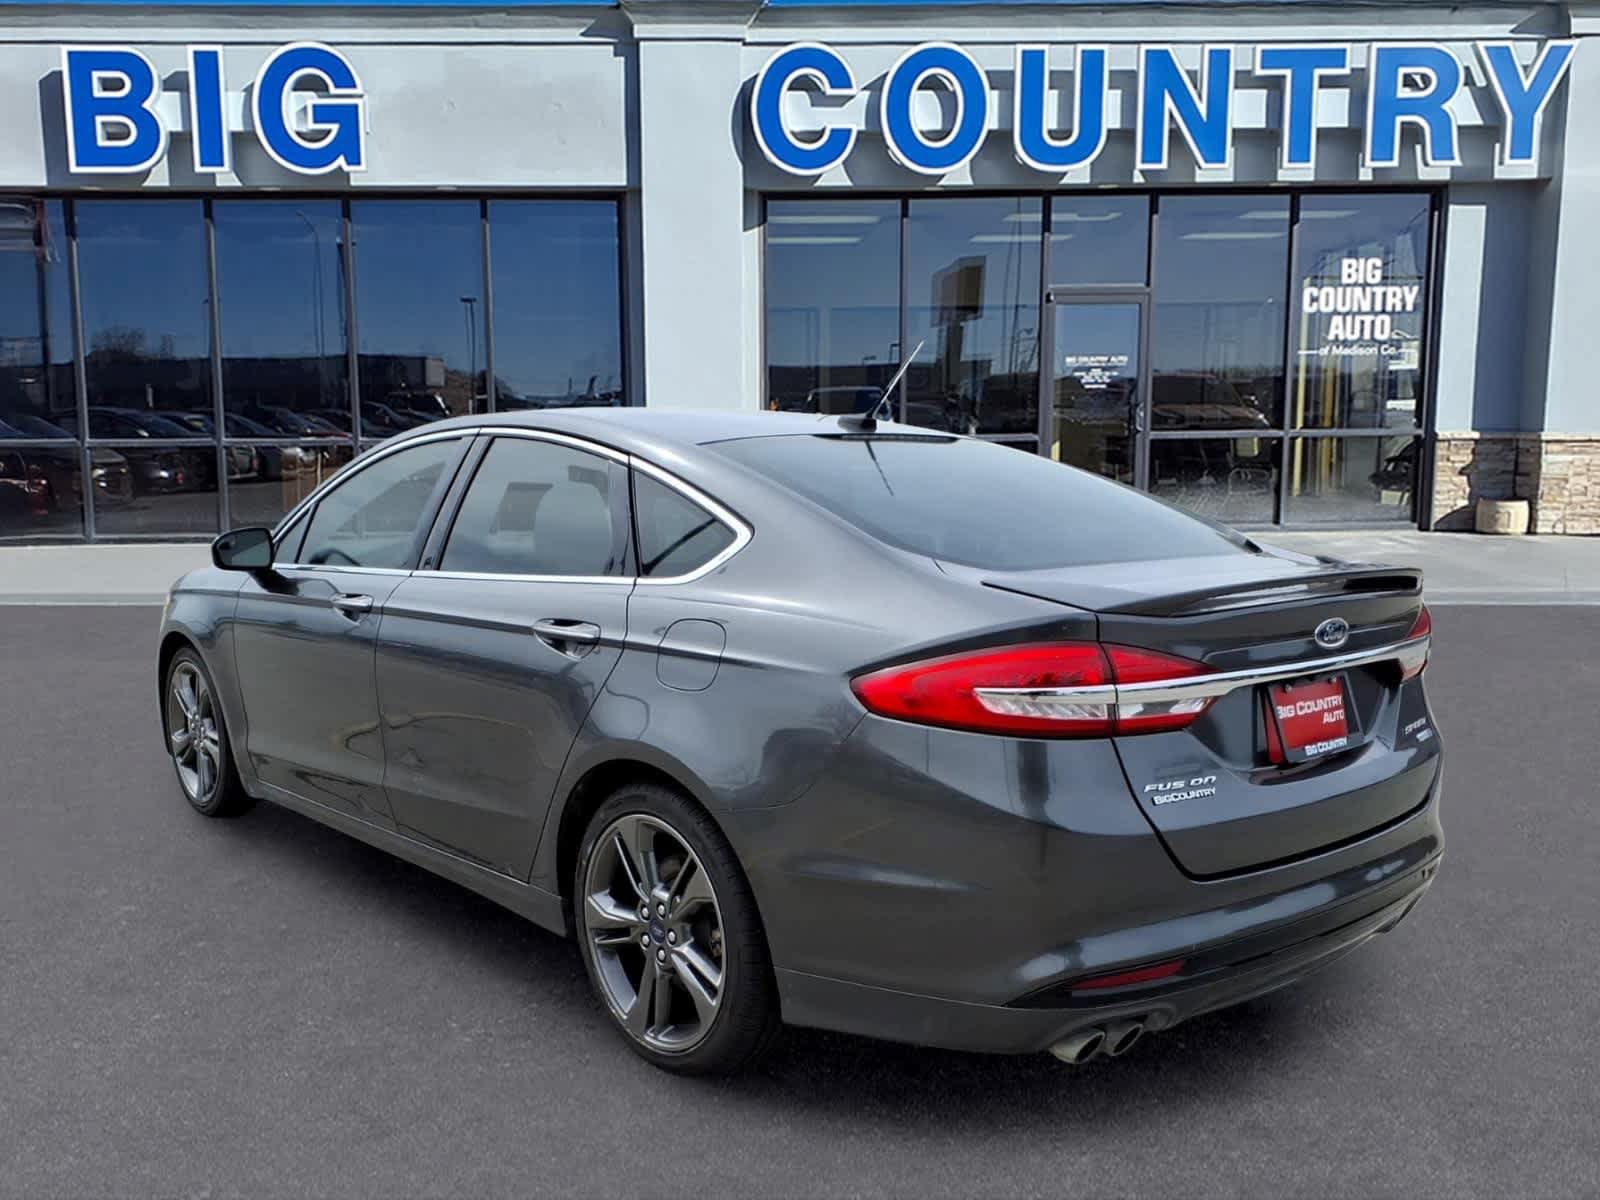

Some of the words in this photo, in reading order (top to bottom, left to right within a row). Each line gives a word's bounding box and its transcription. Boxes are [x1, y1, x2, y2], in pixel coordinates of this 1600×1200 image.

[61, 42, 367, 175] BIG
[750, 41, 1575, 176] COUNTRY
[1341, 257, 1382, 285] BIG
[1302, 285, 1419, 313] COUNTRY
[1327, 313, 1392, 341] AUTO
[1319, 344, 1330, 356] of
[1331, 344, 1378, 356] Madison
[1296, 694, 1344, 715] COUNTRY
[1322, 710, 1346, 725] AUTO
